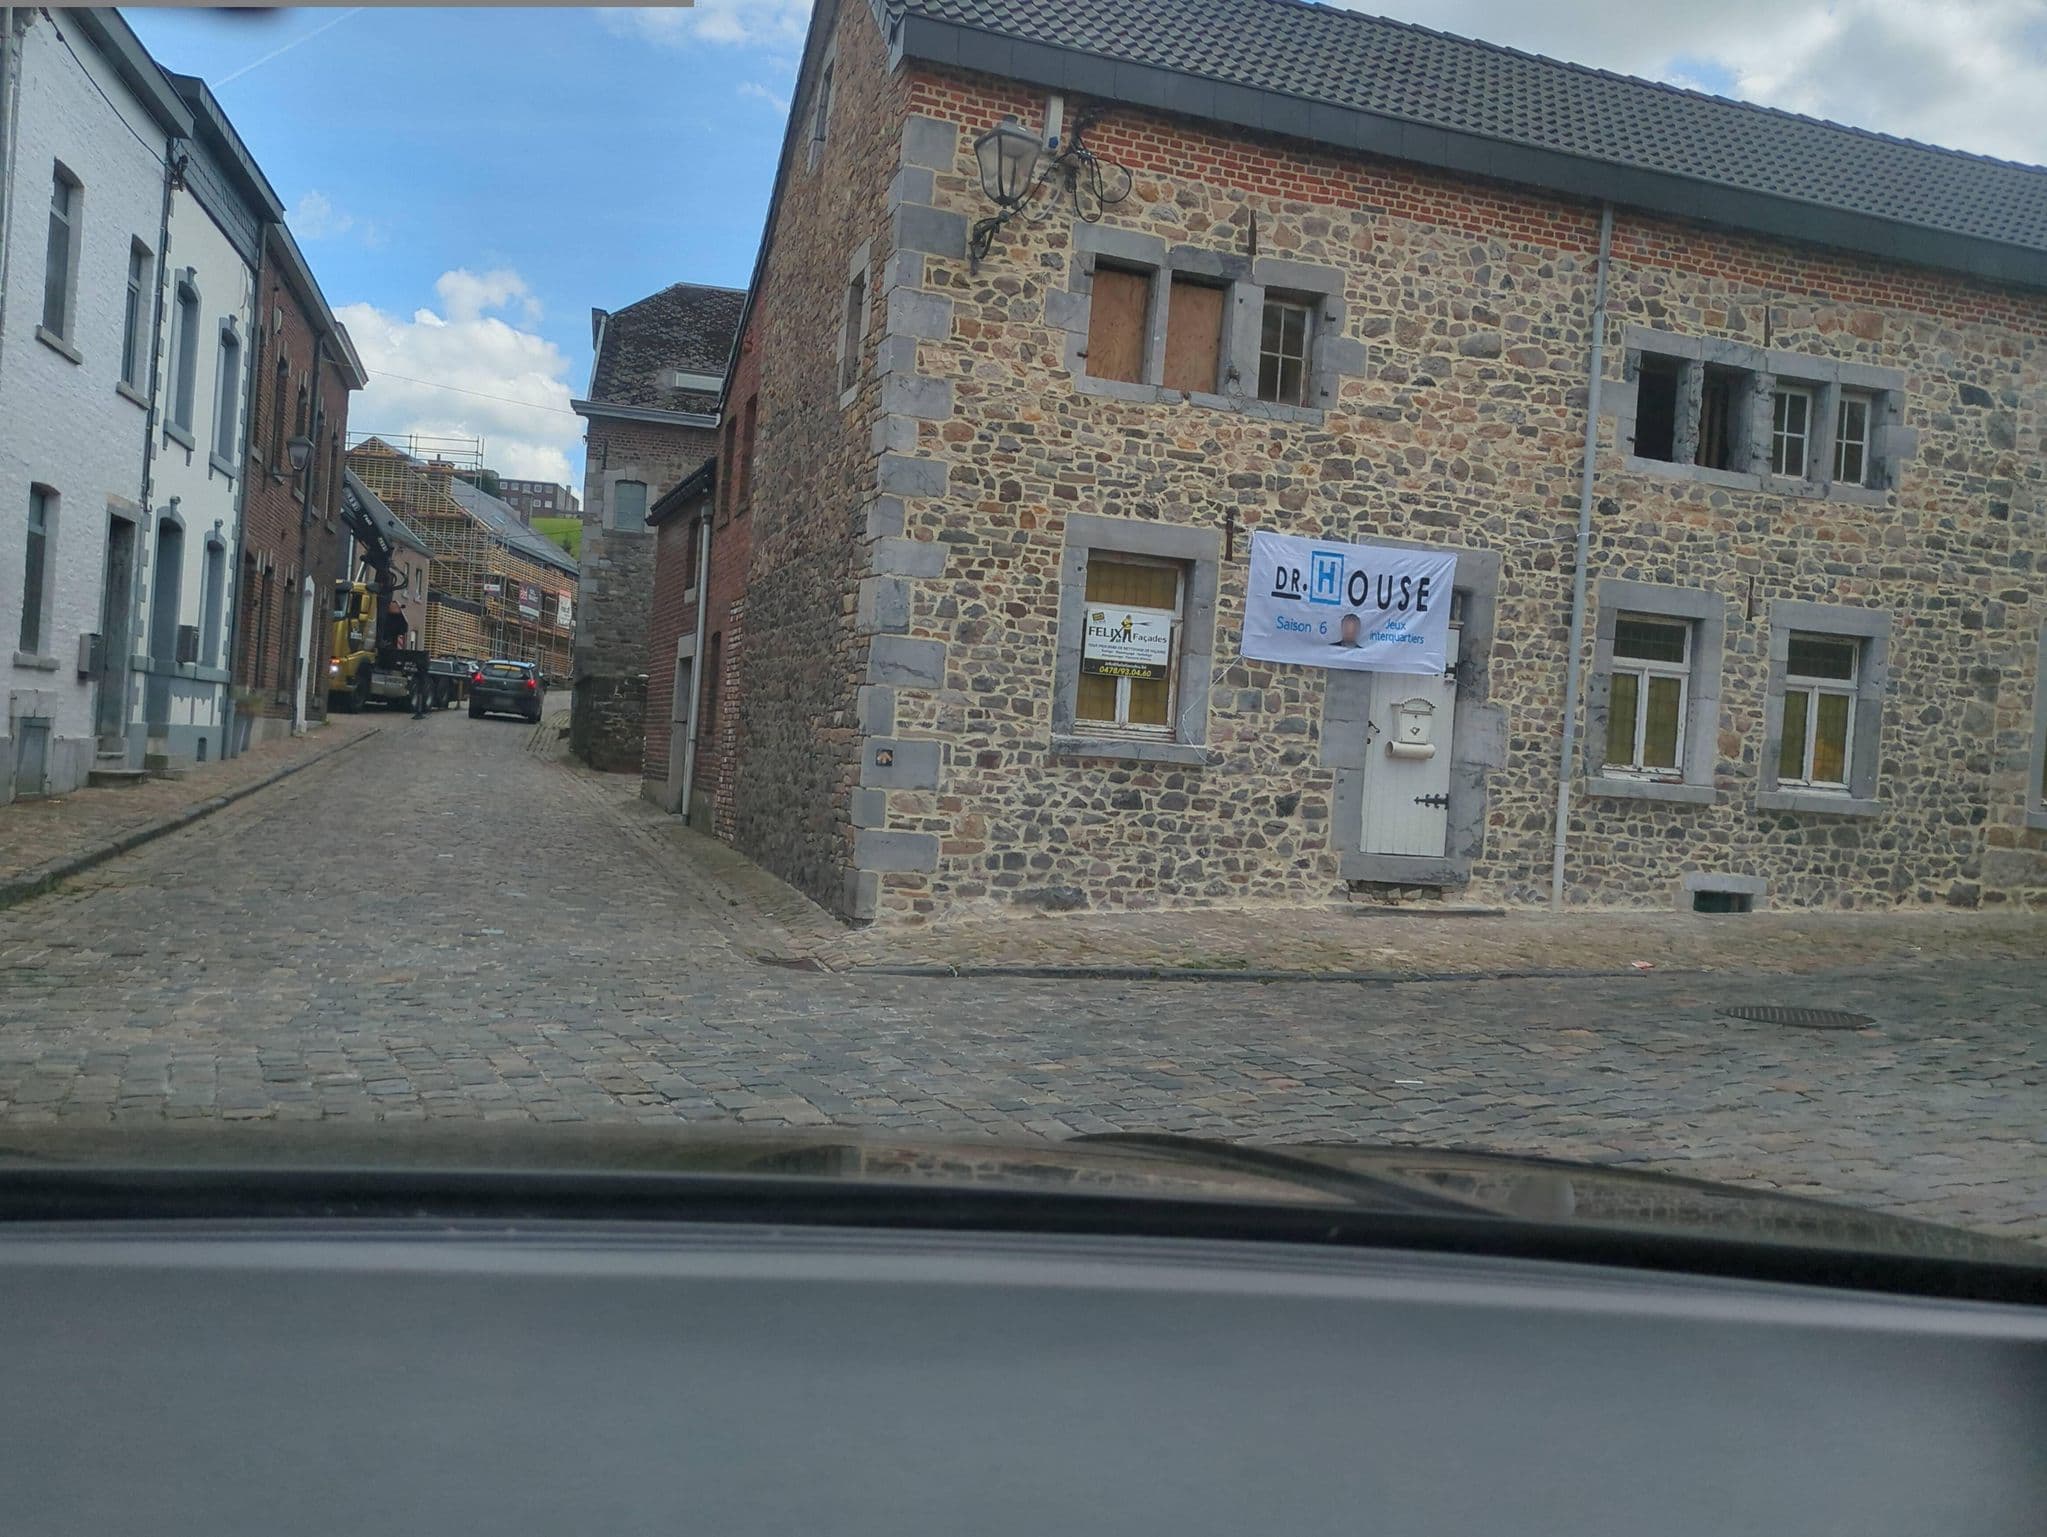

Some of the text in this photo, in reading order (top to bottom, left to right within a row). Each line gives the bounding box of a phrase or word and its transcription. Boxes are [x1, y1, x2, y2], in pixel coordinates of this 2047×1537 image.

[1274, 566, 1308, 593] DR.
[1276, 615, 1328, 635] Saison 6
[1385, 618, 1407, 631] Jeux
[1088, 626, 1168, 644] FELIX Façades
[1369, 628, 1424, 645] interquartiers
